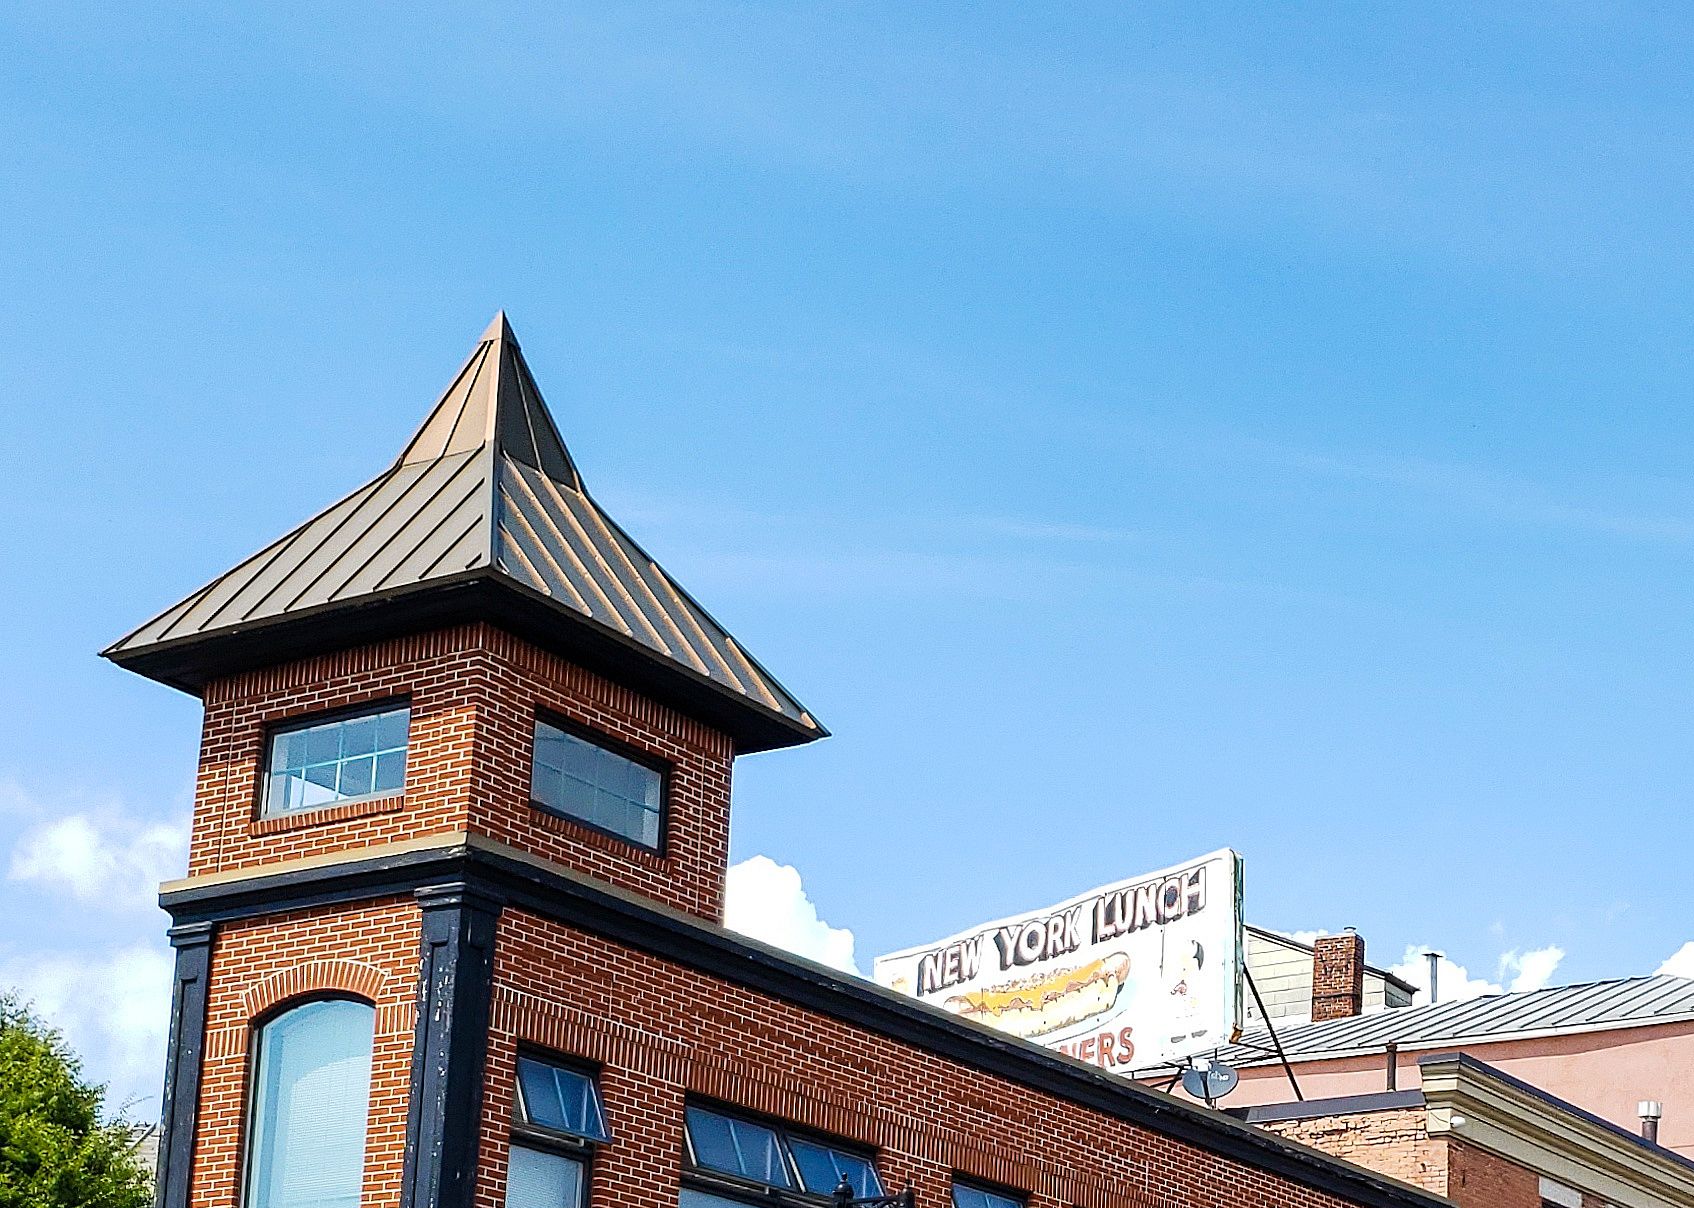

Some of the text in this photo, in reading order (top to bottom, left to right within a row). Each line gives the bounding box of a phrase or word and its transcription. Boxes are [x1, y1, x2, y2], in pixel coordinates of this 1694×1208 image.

[918, 867, 1207, 997] NEW YORK LUNCH
